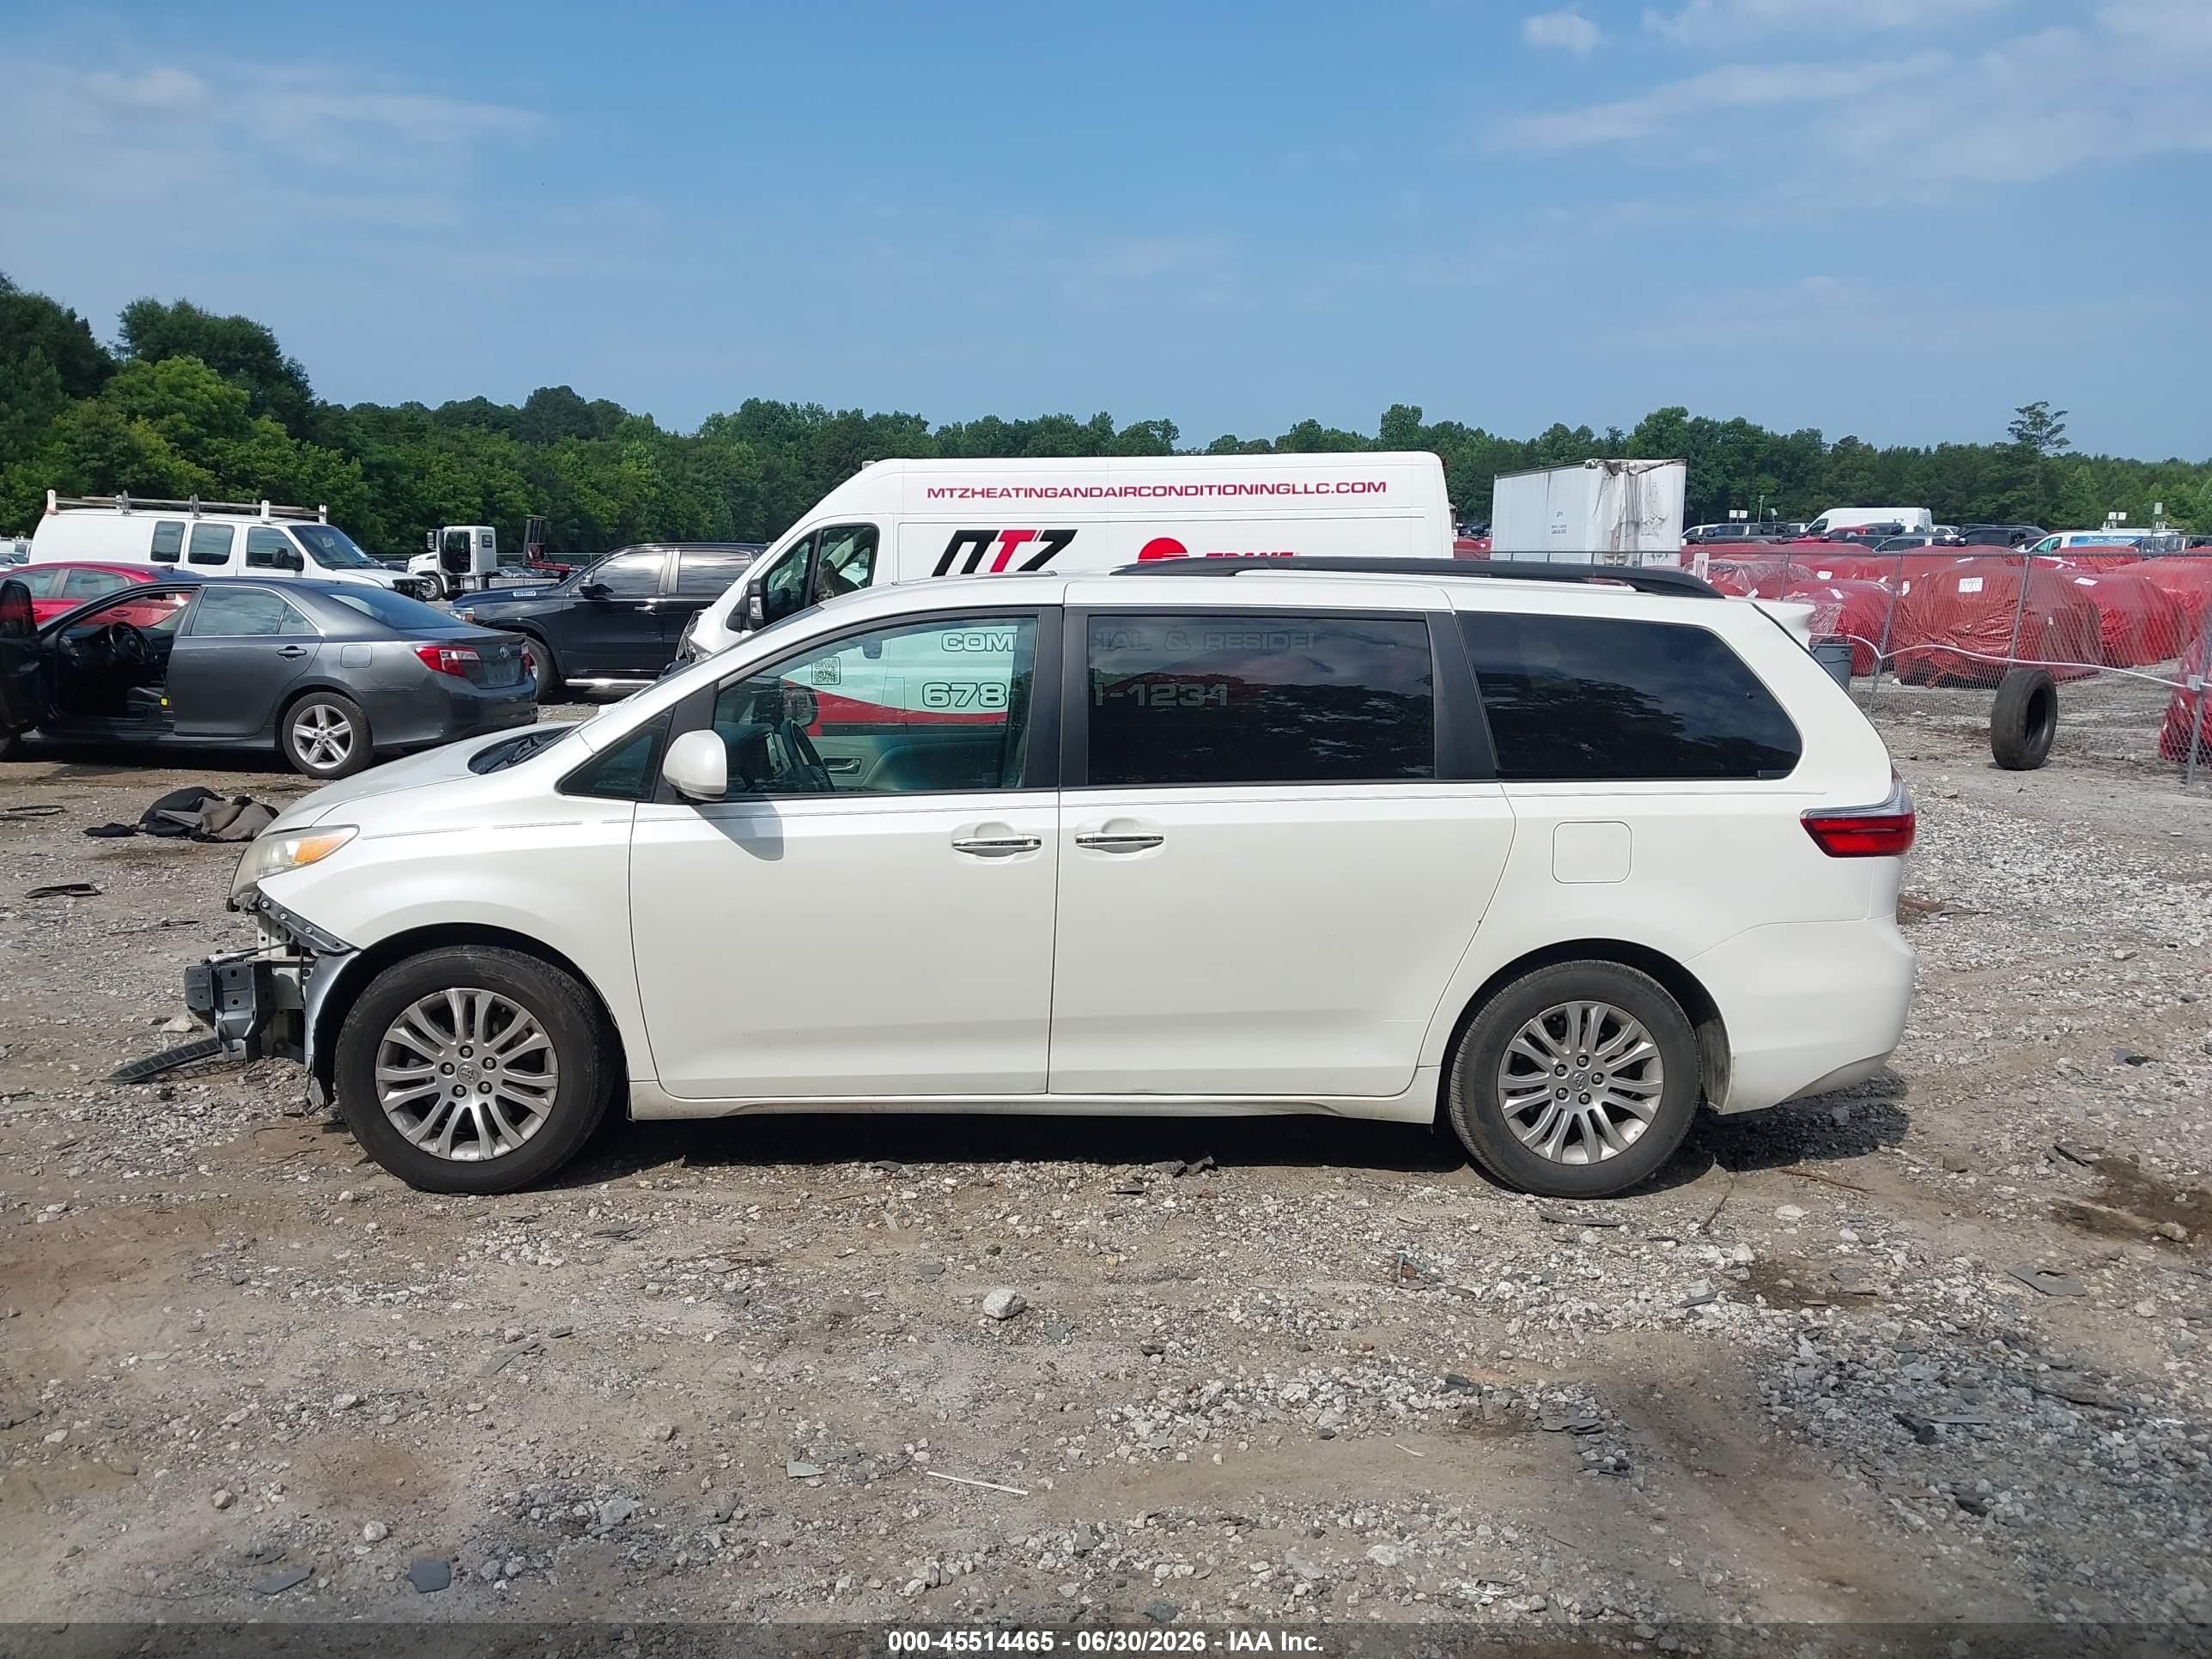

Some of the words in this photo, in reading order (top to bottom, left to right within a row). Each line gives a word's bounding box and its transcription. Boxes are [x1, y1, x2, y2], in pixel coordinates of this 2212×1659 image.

[927, 481, 1387, 499] MTZHEATINGANDAIRCONDITIONINGLLC.COM
[1164, 631, 1190, 651] &
[922, 682, 1006, 708] 678
